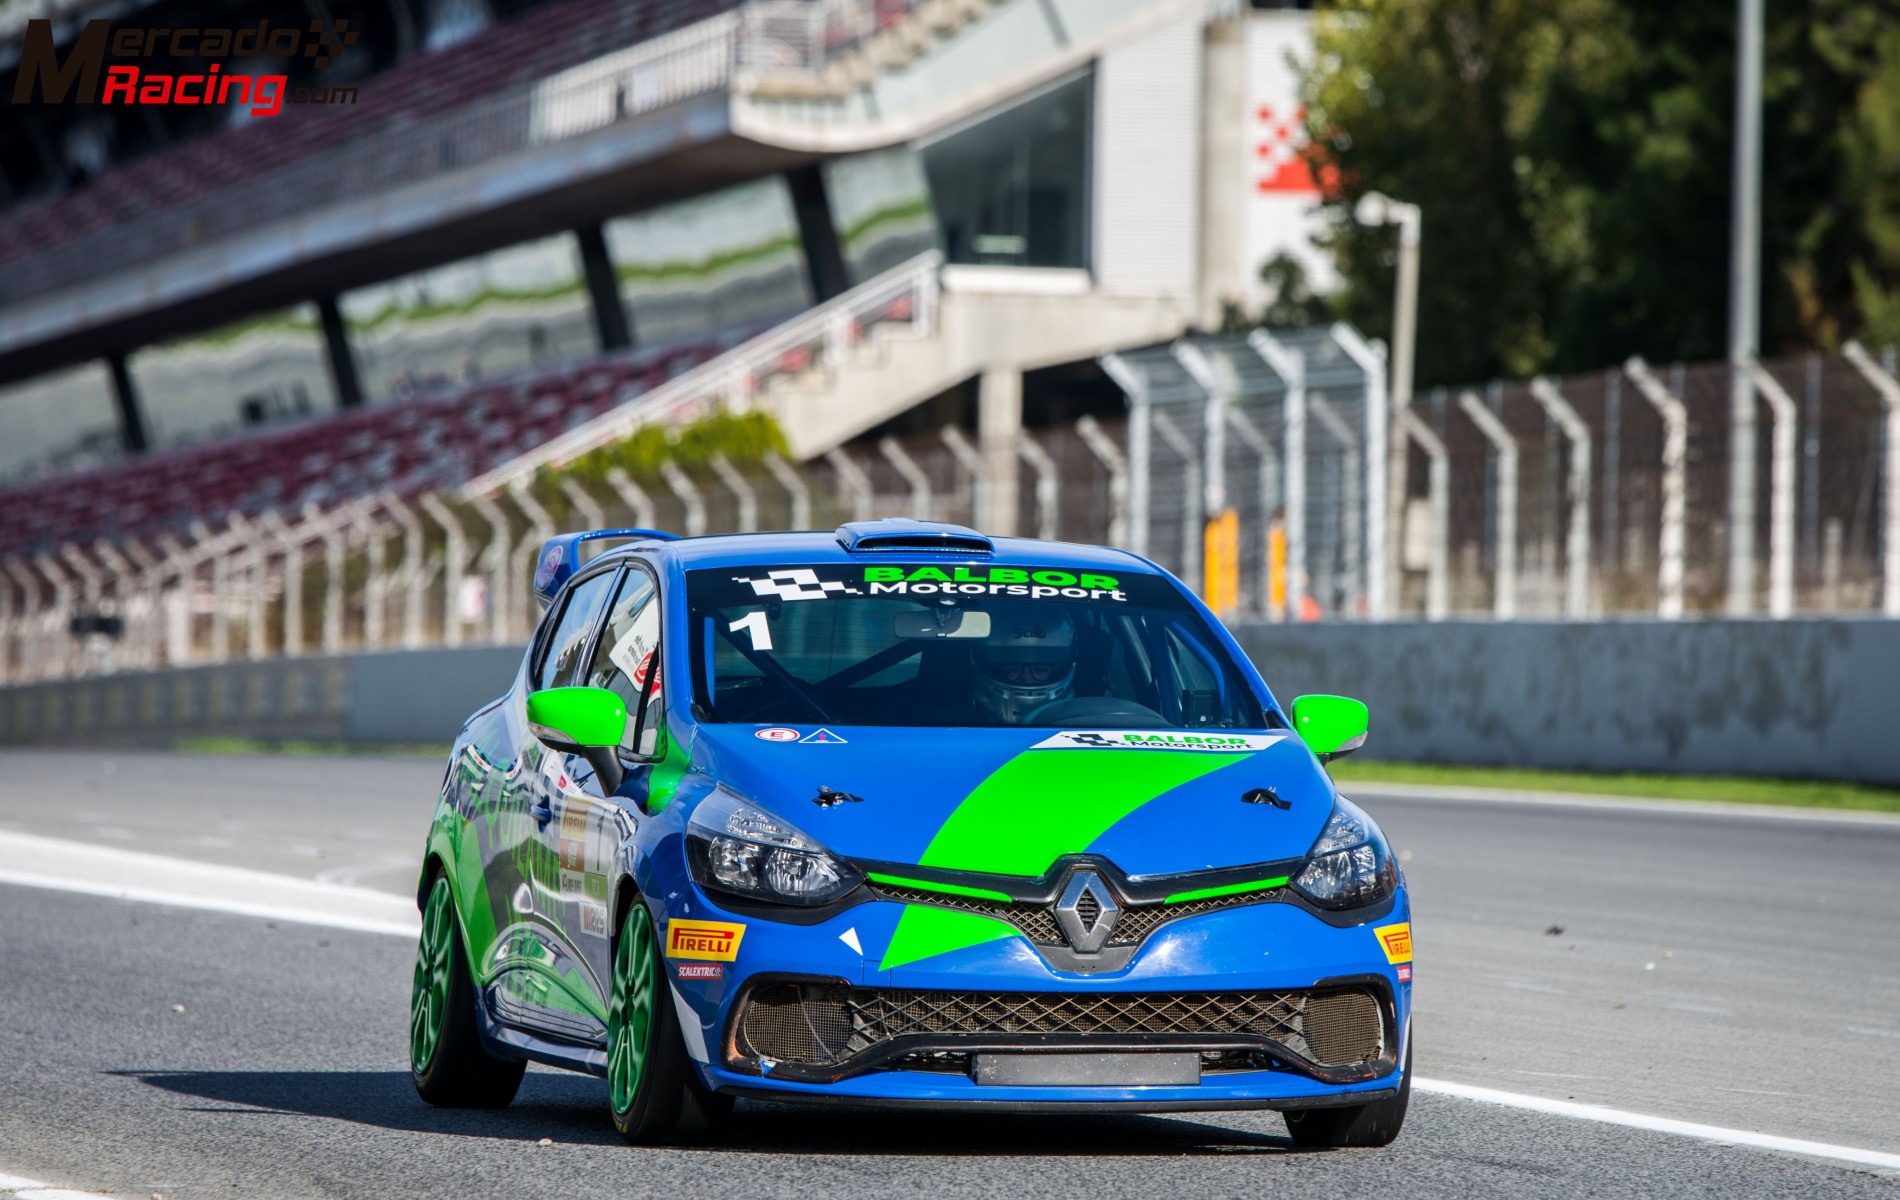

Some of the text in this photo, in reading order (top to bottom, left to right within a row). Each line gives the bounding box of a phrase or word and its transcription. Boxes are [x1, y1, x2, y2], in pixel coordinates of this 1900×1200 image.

[864, 567, 1120, 590] BALBOR
[869, 581, 1127, 602] Motorsport
[728, 611, 773, 651] 1
[1123, 734, 1247, 745] BALBOR
[1128, 741, 1255, 750] Motorsport
[672, 927, 735, 953] PIRELLI
[1382, 931, 1411, 956] PIRELLI
[678, 966, 717, 977] SCALEXTRIC
